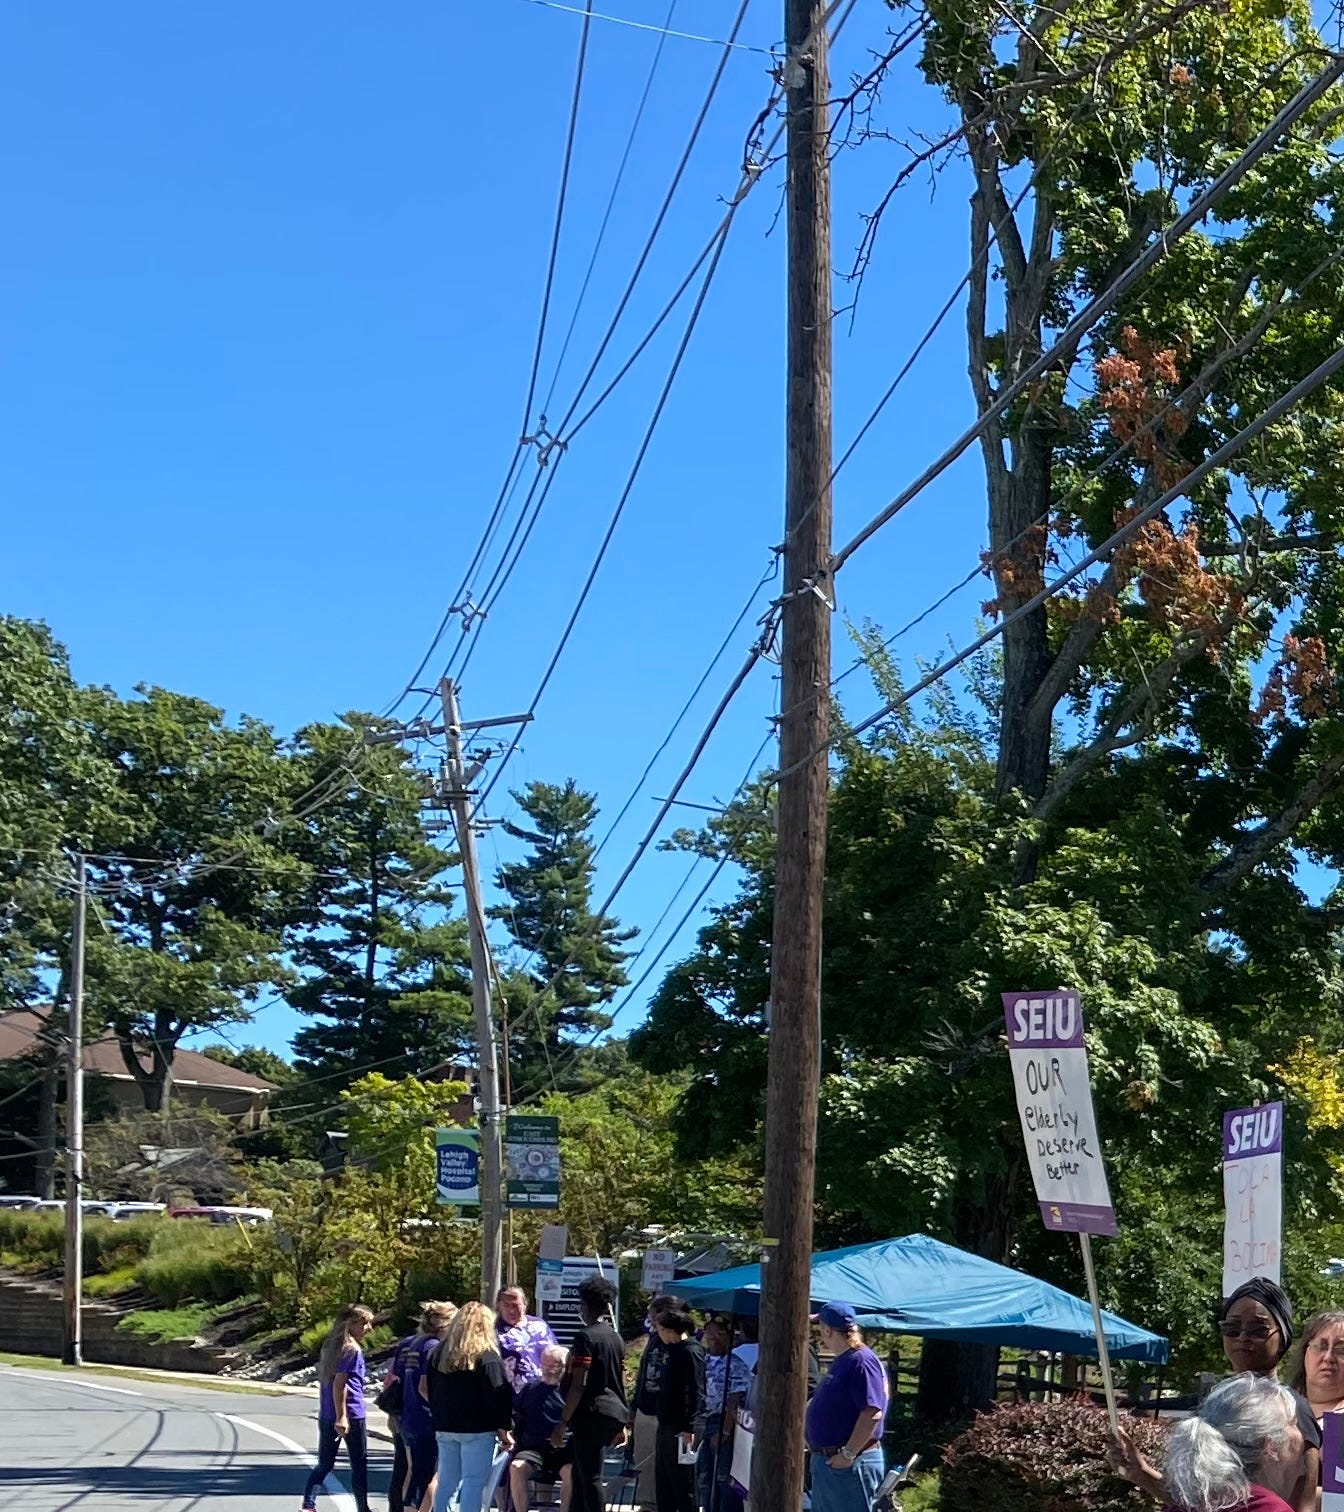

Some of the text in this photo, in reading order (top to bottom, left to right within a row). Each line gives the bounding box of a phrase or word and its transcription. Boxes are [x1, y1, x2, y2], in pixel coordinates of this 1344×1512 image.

[1013, 998, 1075, 1041] SEIU
[1026, 1058, 1067, 1096] OUR
[1228, 1110, 1277, 1154] SEIU
[440, 1150, 469, 1160] Lehigh
[440, 1159, 466, 1169] Valley
[440, 1167, 476, 1176] Hospital
[440, 1174, 471, 1183] Pocono
[653, 1253, 665, 1261] NO
